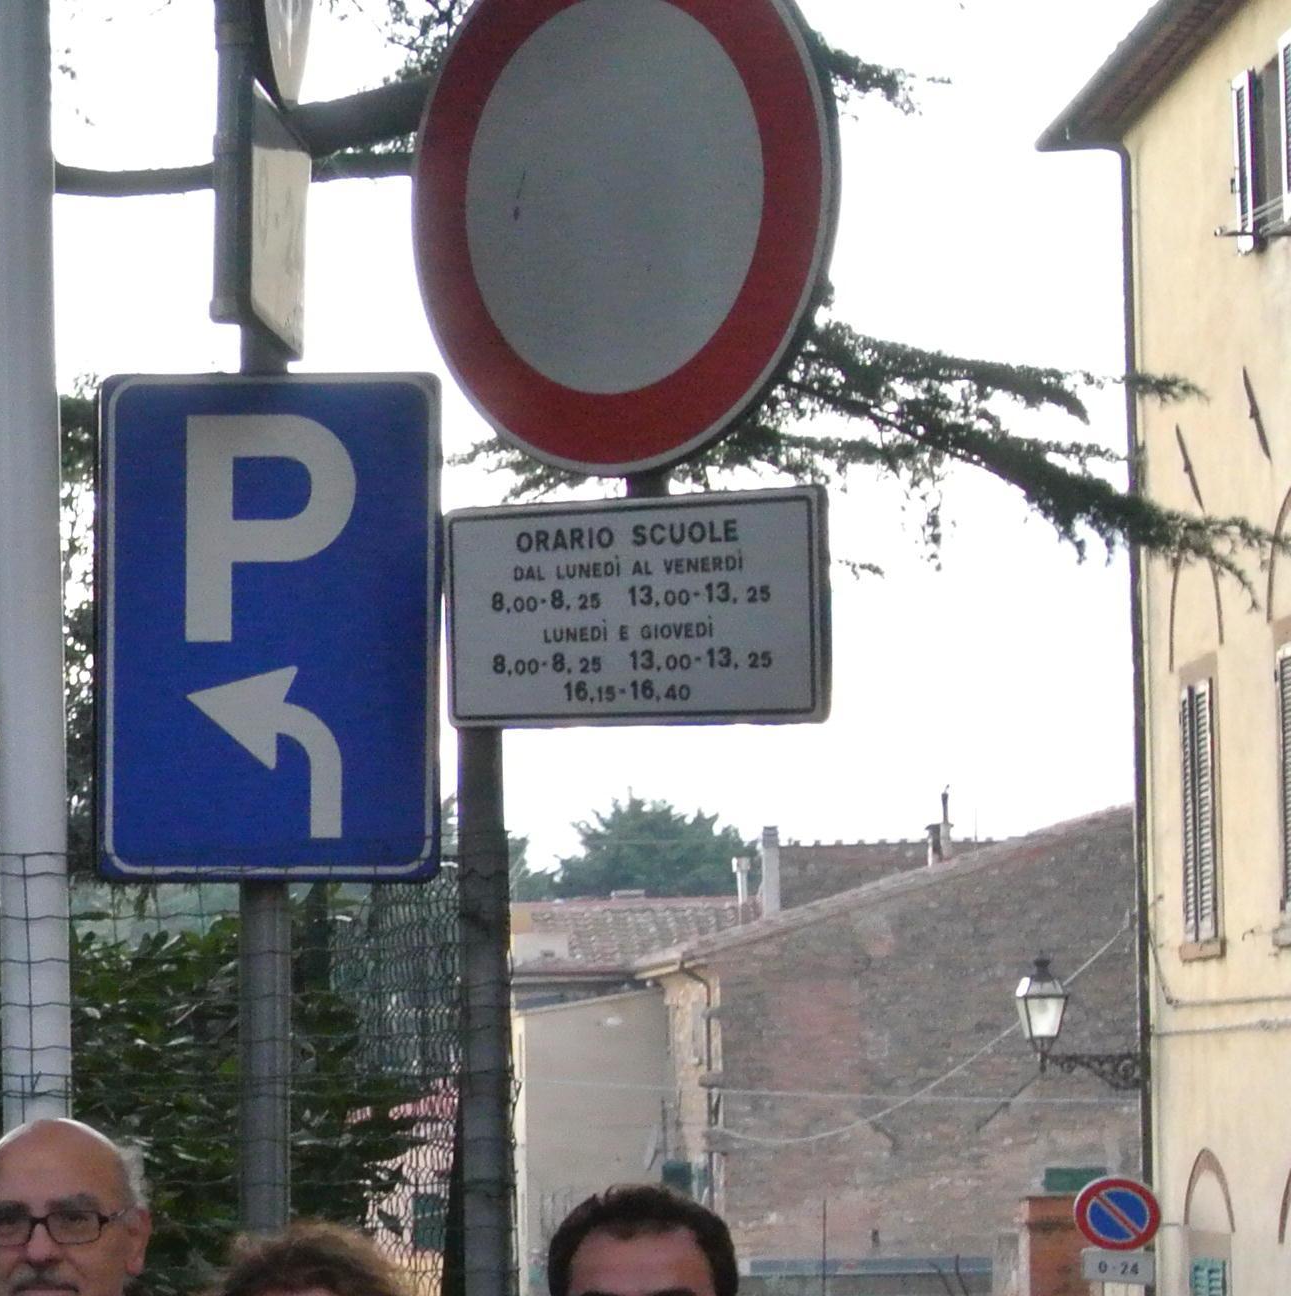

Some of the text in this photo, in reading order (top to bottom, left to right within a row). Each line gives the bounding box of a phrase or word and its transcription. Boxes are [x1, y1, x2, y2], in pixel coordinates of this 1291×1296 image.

[185, 414, 356, 642] P
[516, 519, 739, 553] ORARIO SCUOLE
[513, 565, 545, 582] DAL
[632, 560, 652, 576] AL
[619, 625, 629, 641] E
